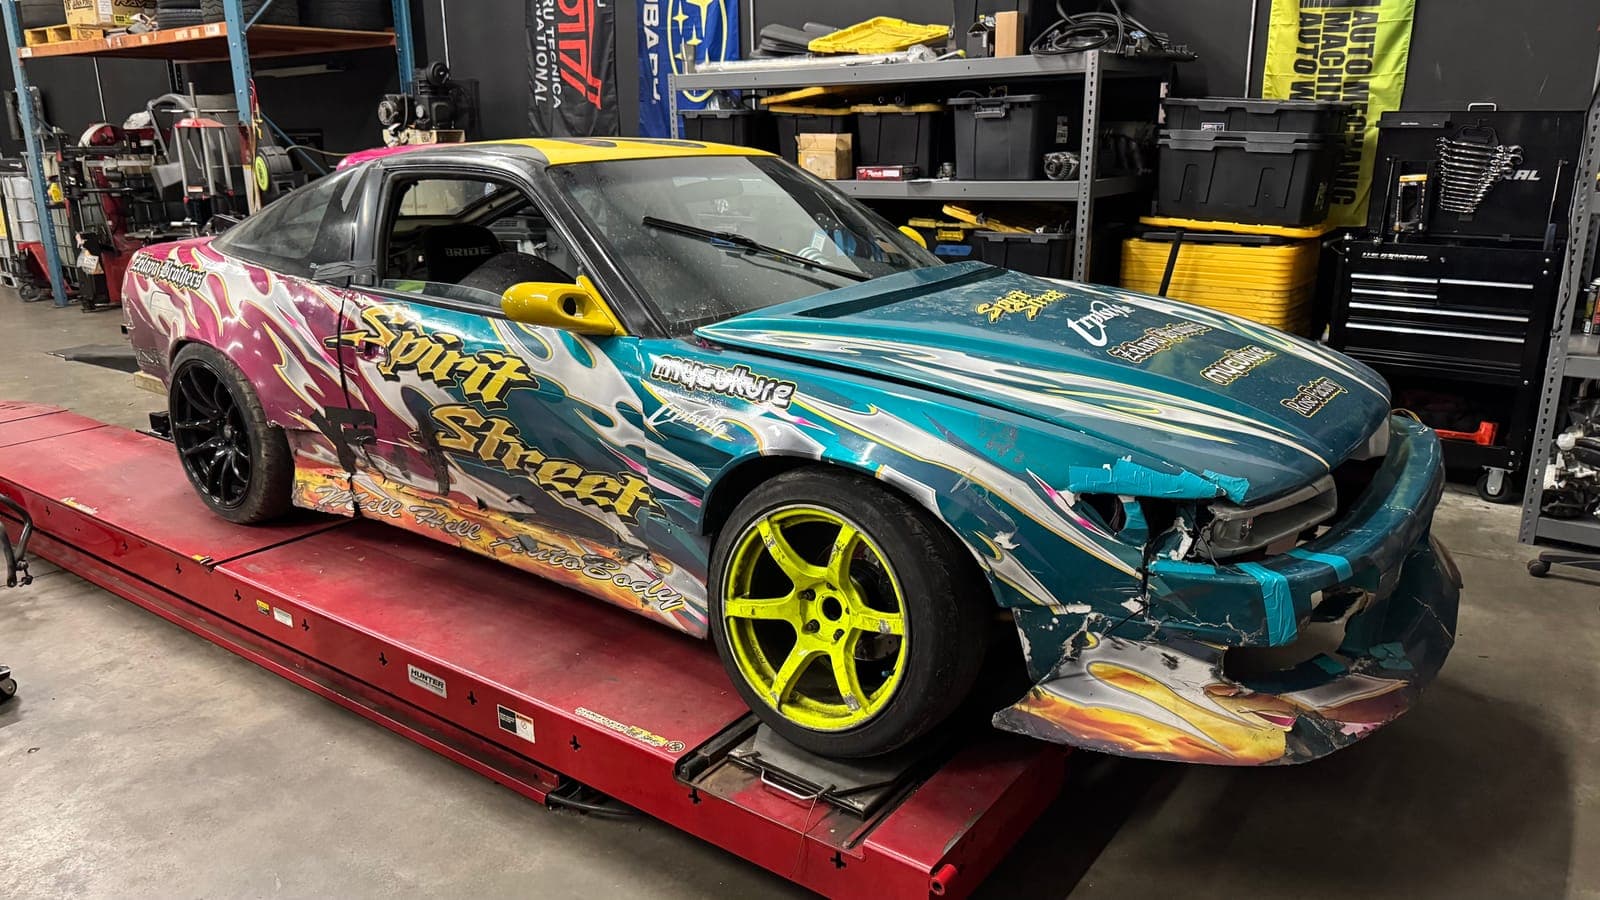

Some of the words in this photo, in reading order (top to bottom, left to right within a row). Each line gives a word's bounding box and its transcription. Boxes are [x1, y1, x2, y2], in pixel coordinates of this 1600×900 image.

[549, 25, 562, 109] TECNICA
[643, 0, 661, 101] BARU
[1293, 12, 1323, 75] AUTO
[1345, 10, 1379, 75] AUTO
[1330, 80, 1370, 206] MECHANIC
[160, 258, 207, 290] Brothers
[444, 246, 491, 257] BRIDE
[325, 303, 539, 411] Spirit
[412, 403, 667, 527] Street
[315, 486, 402, 518] Mill
[408, 503, 482, 542] Hill
[410, 668, 444, 689] HUNTER
